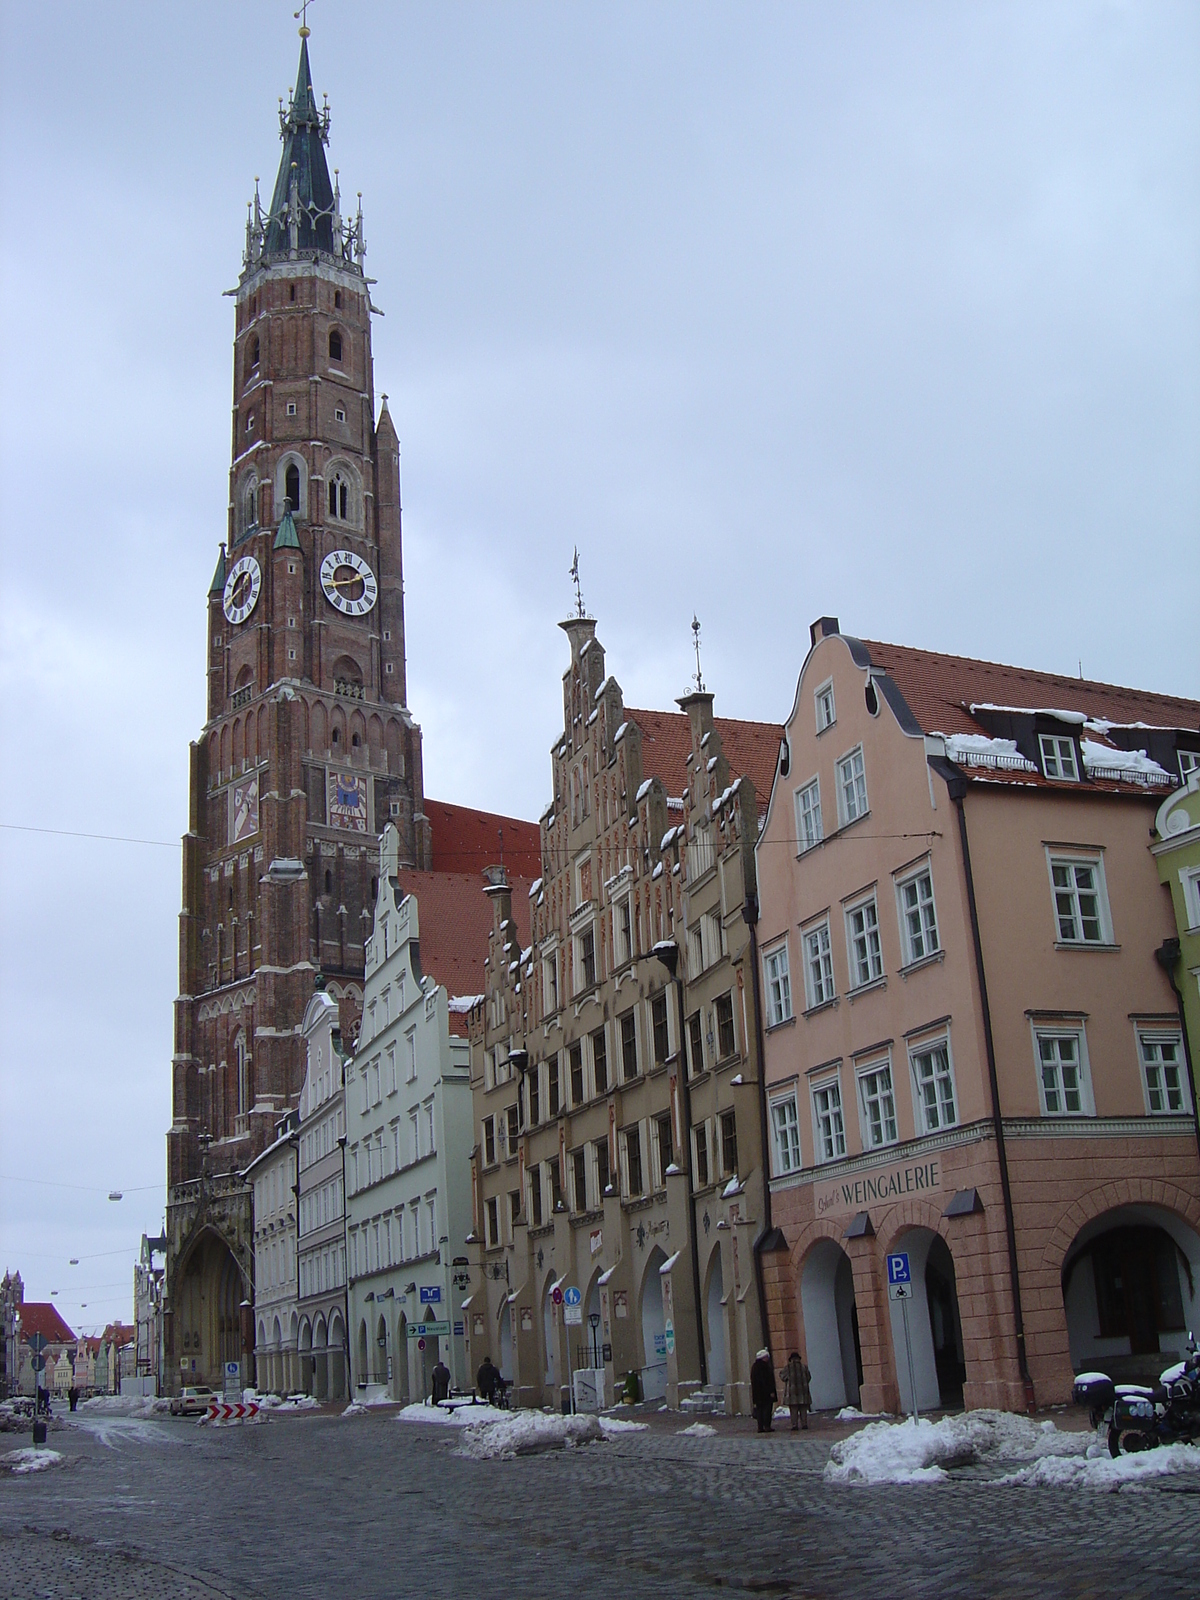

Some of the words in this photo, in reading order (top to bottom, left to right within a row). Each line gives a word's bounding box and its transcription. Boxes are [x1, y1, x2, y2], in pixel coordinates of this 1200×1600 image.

[333, 552, 342, 564] XI
[344, 552, 353, 564] XII
[325, 560, 334, 569] X
[362, 572, 373, 580] II
[841, 1162, 940, 1205] WEINGALERIE
[891, 1257, 904, 1280] P
